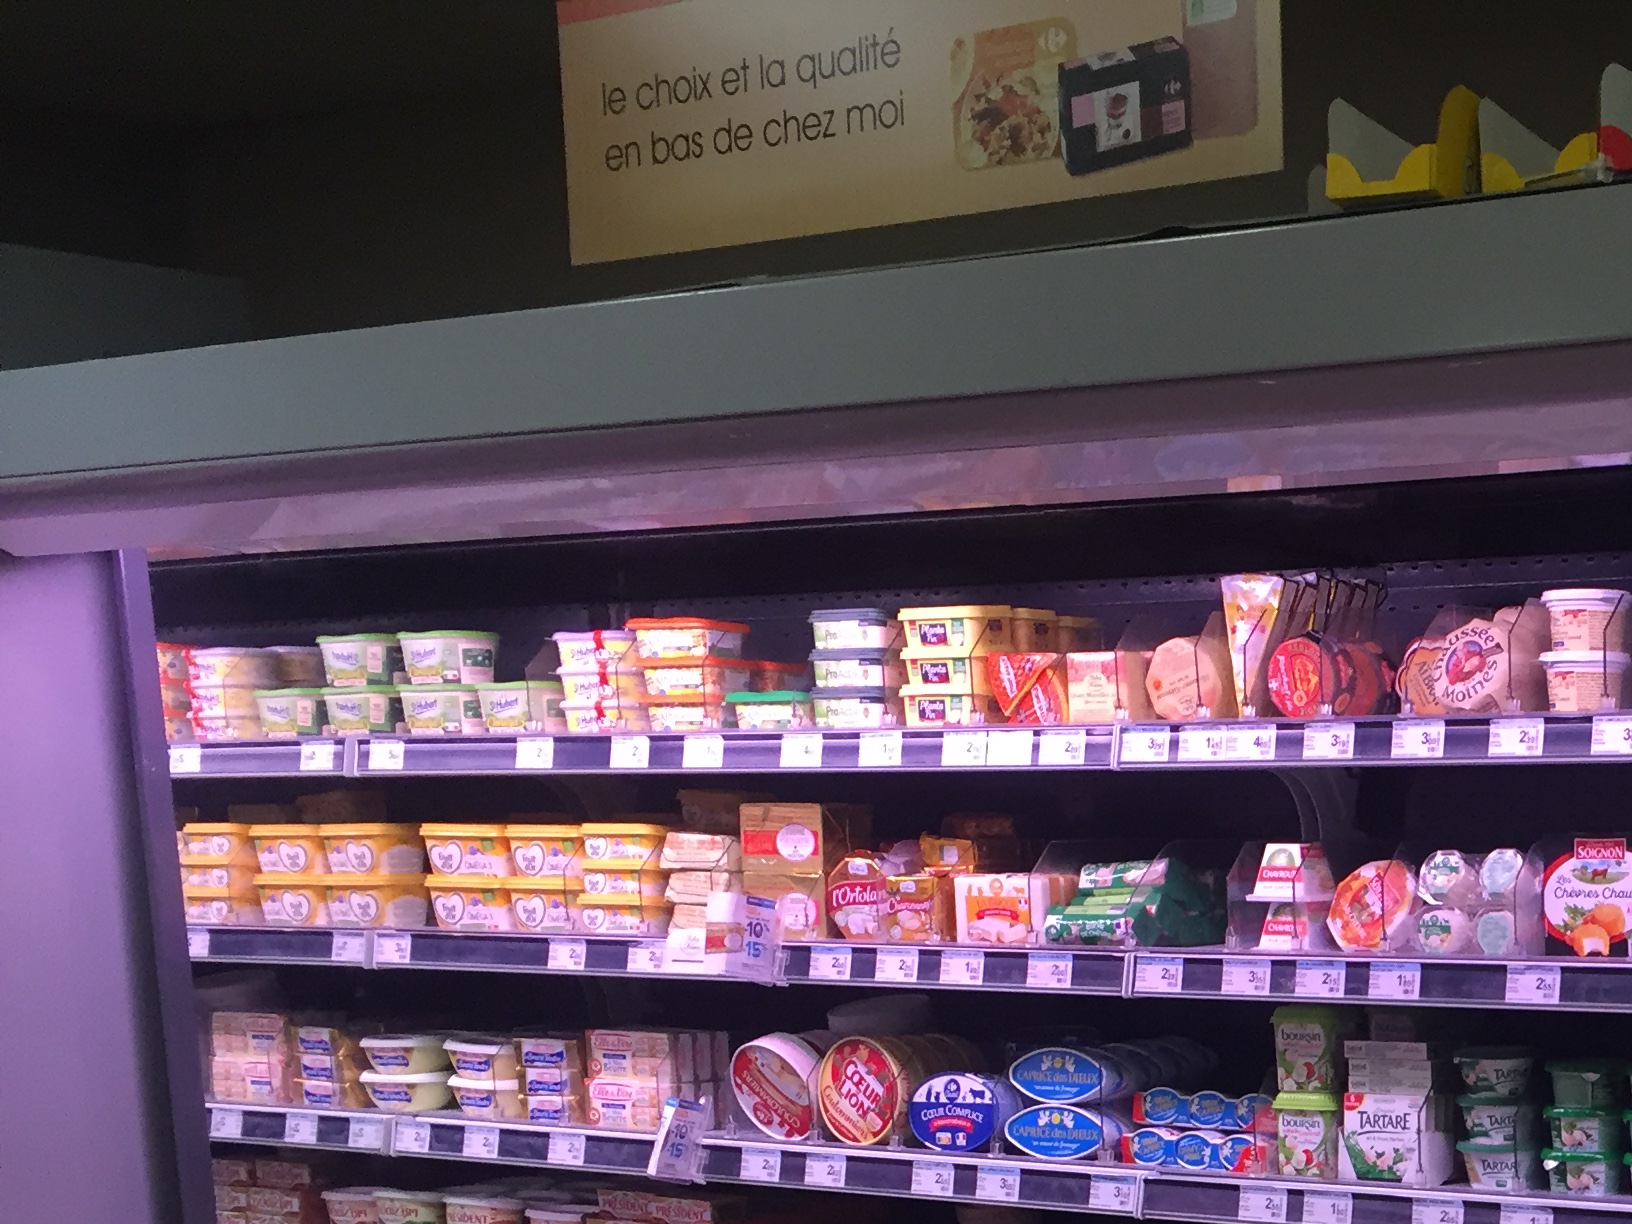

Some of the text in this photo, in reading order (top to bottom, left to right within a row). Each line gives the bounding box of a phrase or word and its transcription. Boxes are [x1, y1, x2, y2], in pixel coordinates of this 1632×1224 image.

[601, 27, 901, 116] le choix et la qualité
[605, 90, 905, 171] en bas de chez moi
[1578, 847, 1623, 858] SOIGNON
[1554, 886, 1600, 899] Chèvres
[1281, 1114, 1320, 1130] boursin
[1357, 1111, 1411, 1131] TARTARE
